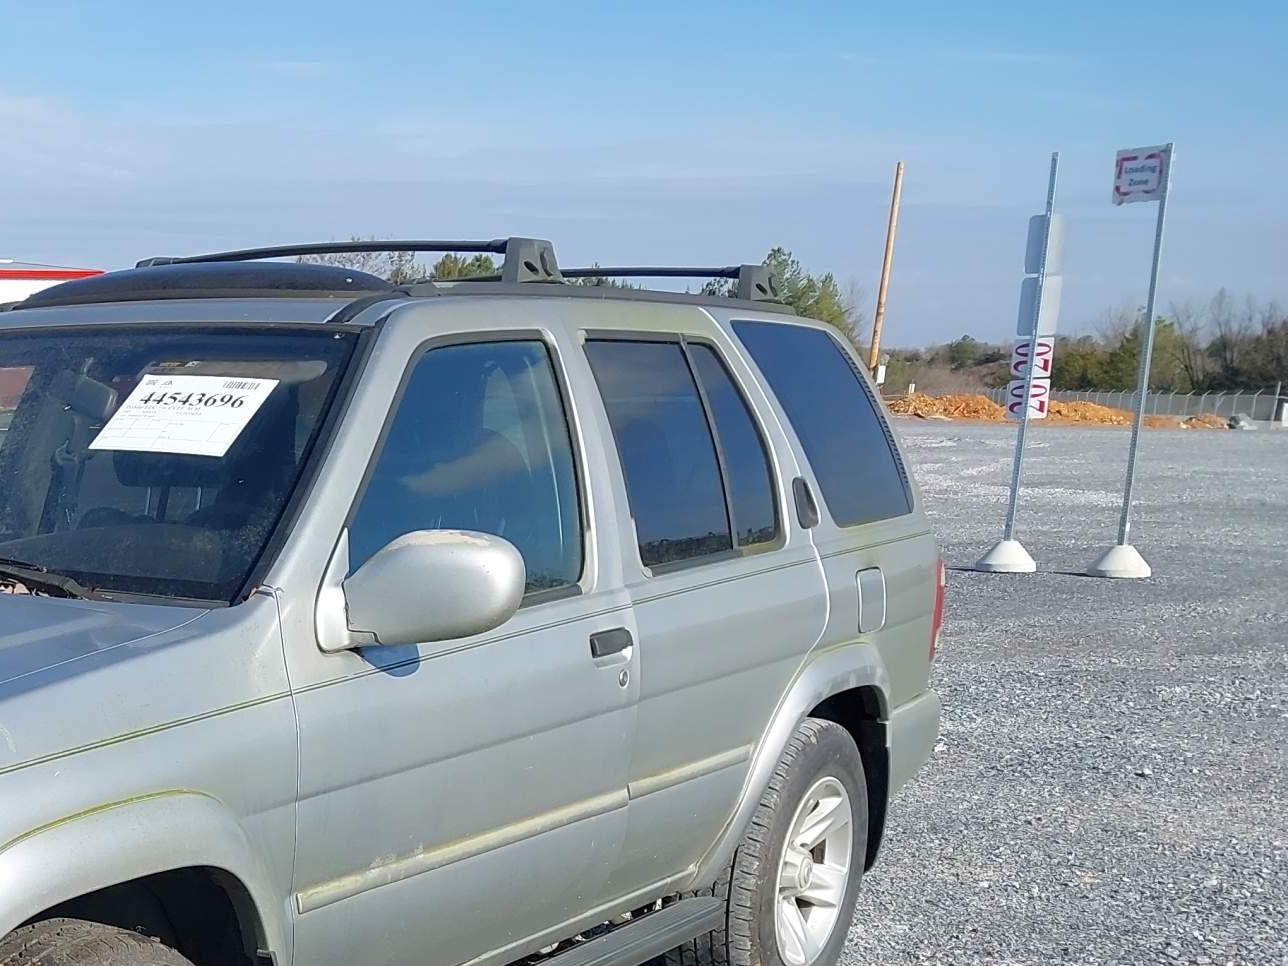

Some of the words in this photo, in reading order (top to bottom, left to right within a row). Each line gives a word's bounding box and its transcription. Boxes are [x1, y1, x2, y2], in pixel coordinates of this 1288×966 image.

[1124, 165, 1157, 174] Loading
[1128, 178, 1149, 187] Zone
[140, 391, 249, 409] 44543696
